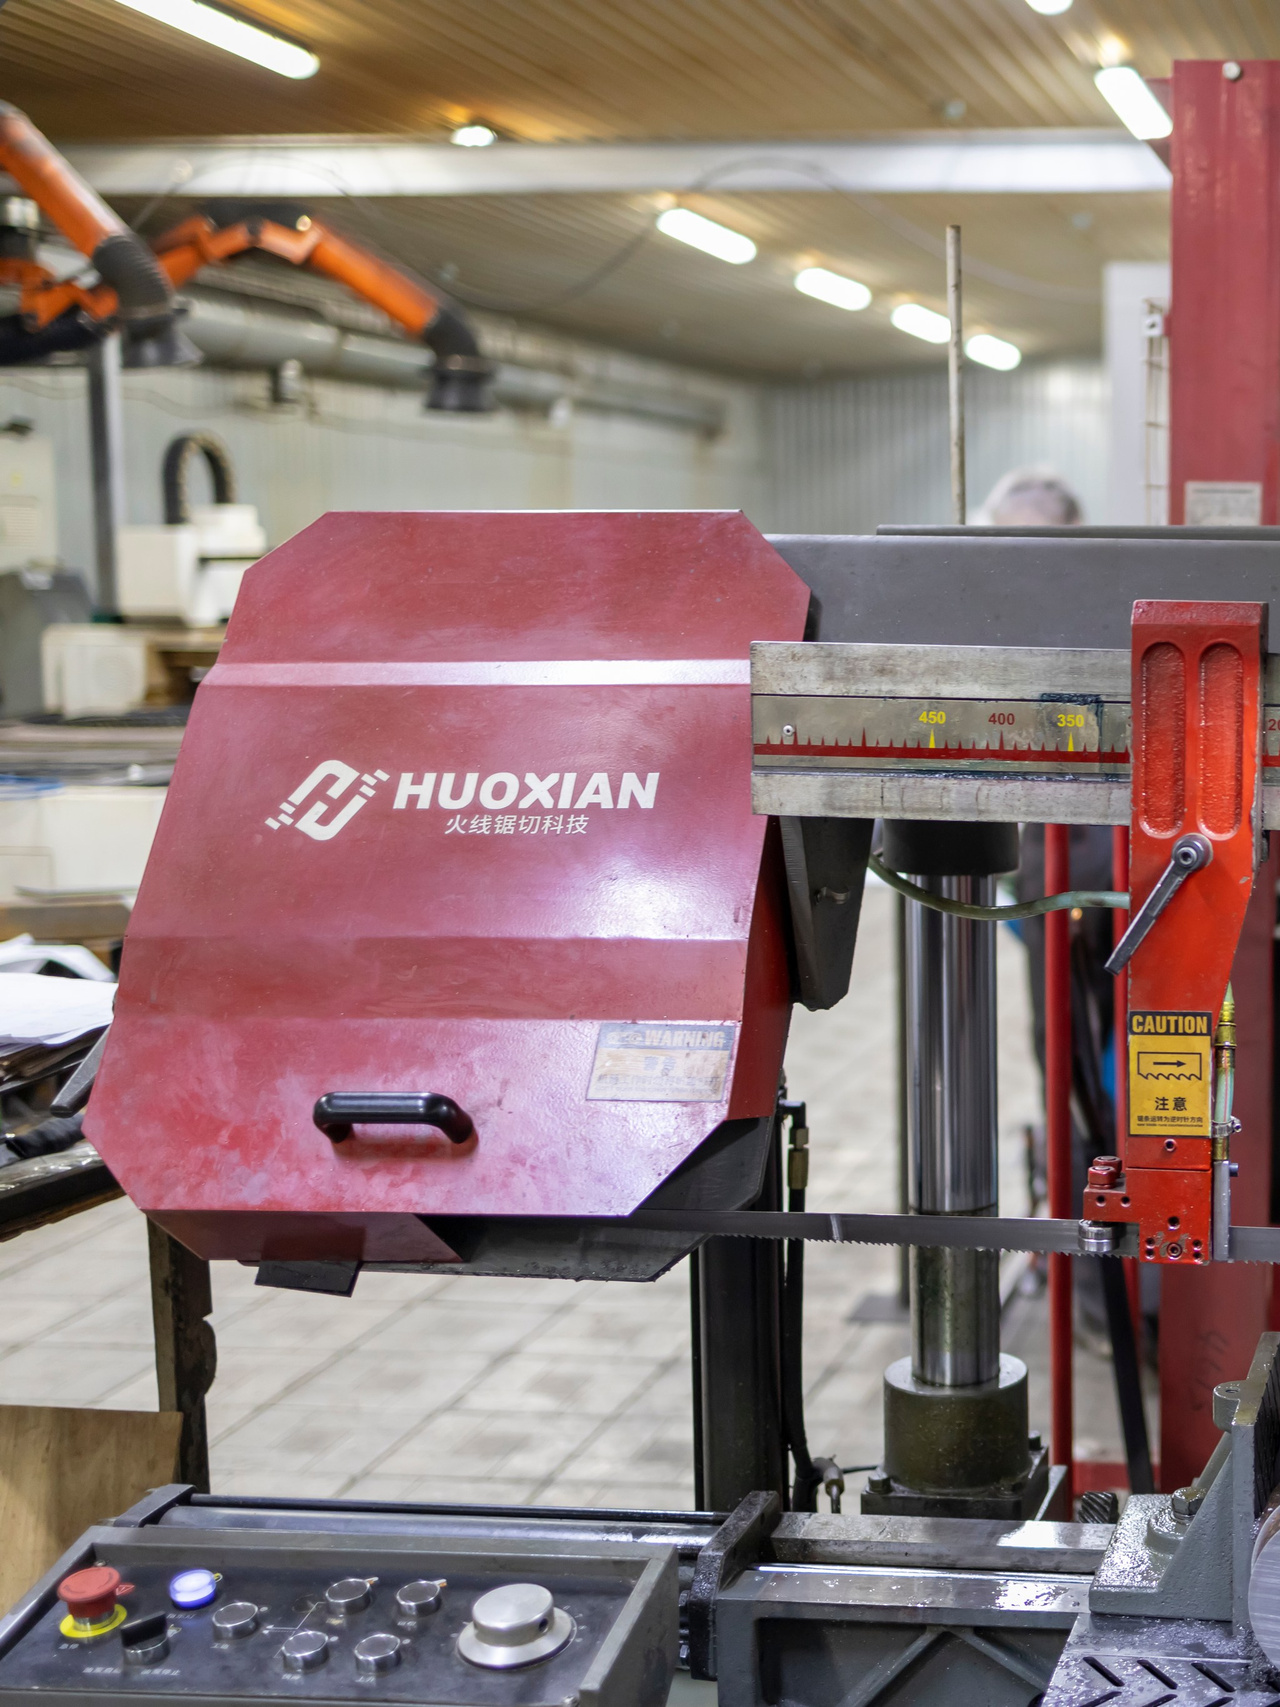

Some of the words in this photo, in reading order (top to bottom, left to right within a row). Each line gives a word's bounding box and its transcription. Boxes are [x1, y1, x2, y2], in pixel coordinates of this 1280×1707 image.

[918, 711, 946, 724] 450
[988, 713, 1015, 725] 400
[1057, 714, 1085, 727] 350
[393, 772, 660, 809] HUOXIAN
[444, 814, 590, 835] 火线锯切科技
[1131, 1014, 1208, 1034] CAUTION
[645, 1029, 725, 1048] WARNING
[1154, 1096, 1187, 1112] 注意
